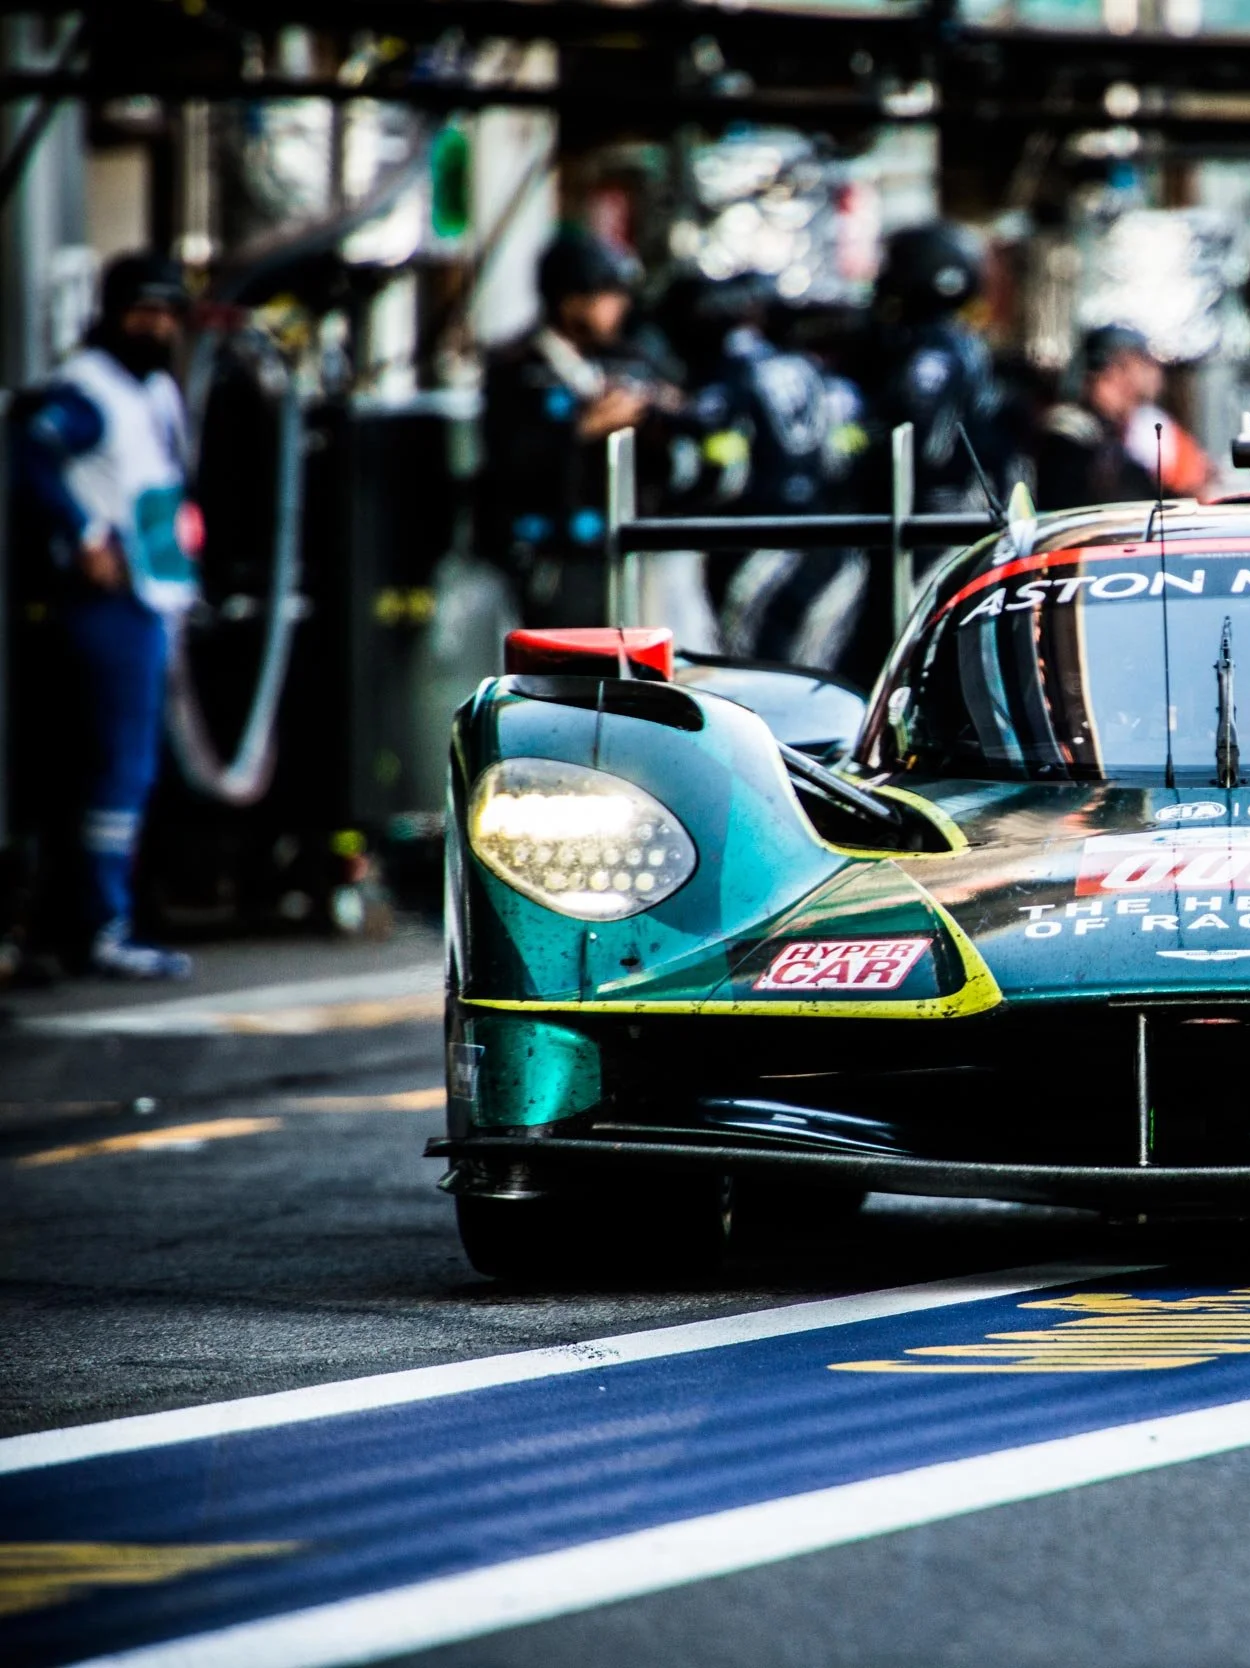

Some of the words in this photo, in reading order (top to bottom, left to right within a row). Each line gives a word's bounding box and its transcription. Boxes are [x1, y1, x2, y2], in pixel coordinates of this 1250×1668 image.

[961, 570, 1206, 626] ASTON
[1018, 898, 1152, 921] THE
[1024, 917, 1110, 939] OF
[786, 943, 915, 960] HYPER
[771, 959, 901, 984] CAR
